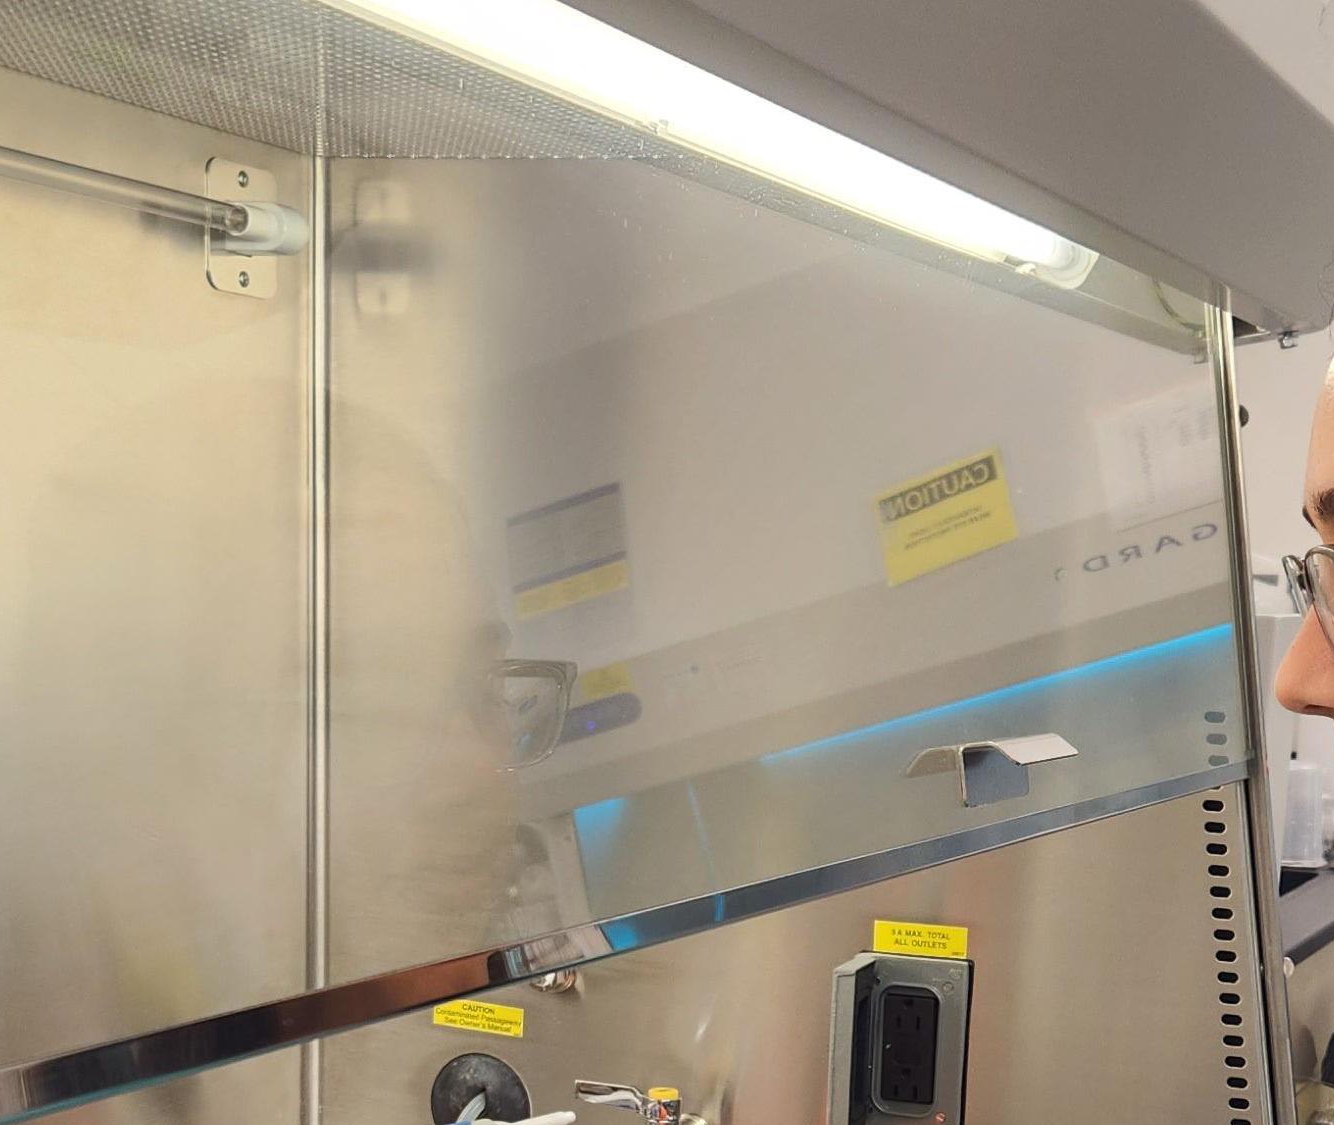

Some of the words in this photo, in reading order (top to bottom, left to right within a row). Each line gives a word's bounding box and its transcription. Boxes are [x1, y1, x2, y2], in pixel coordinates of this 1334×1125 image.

[927, 931, 951, 941] TOTAL
[894, 938, 908, 946] ALL
[911, 940, 947, 950] OUTLETS
[462, 1003, 495, 1015] CAUTION
